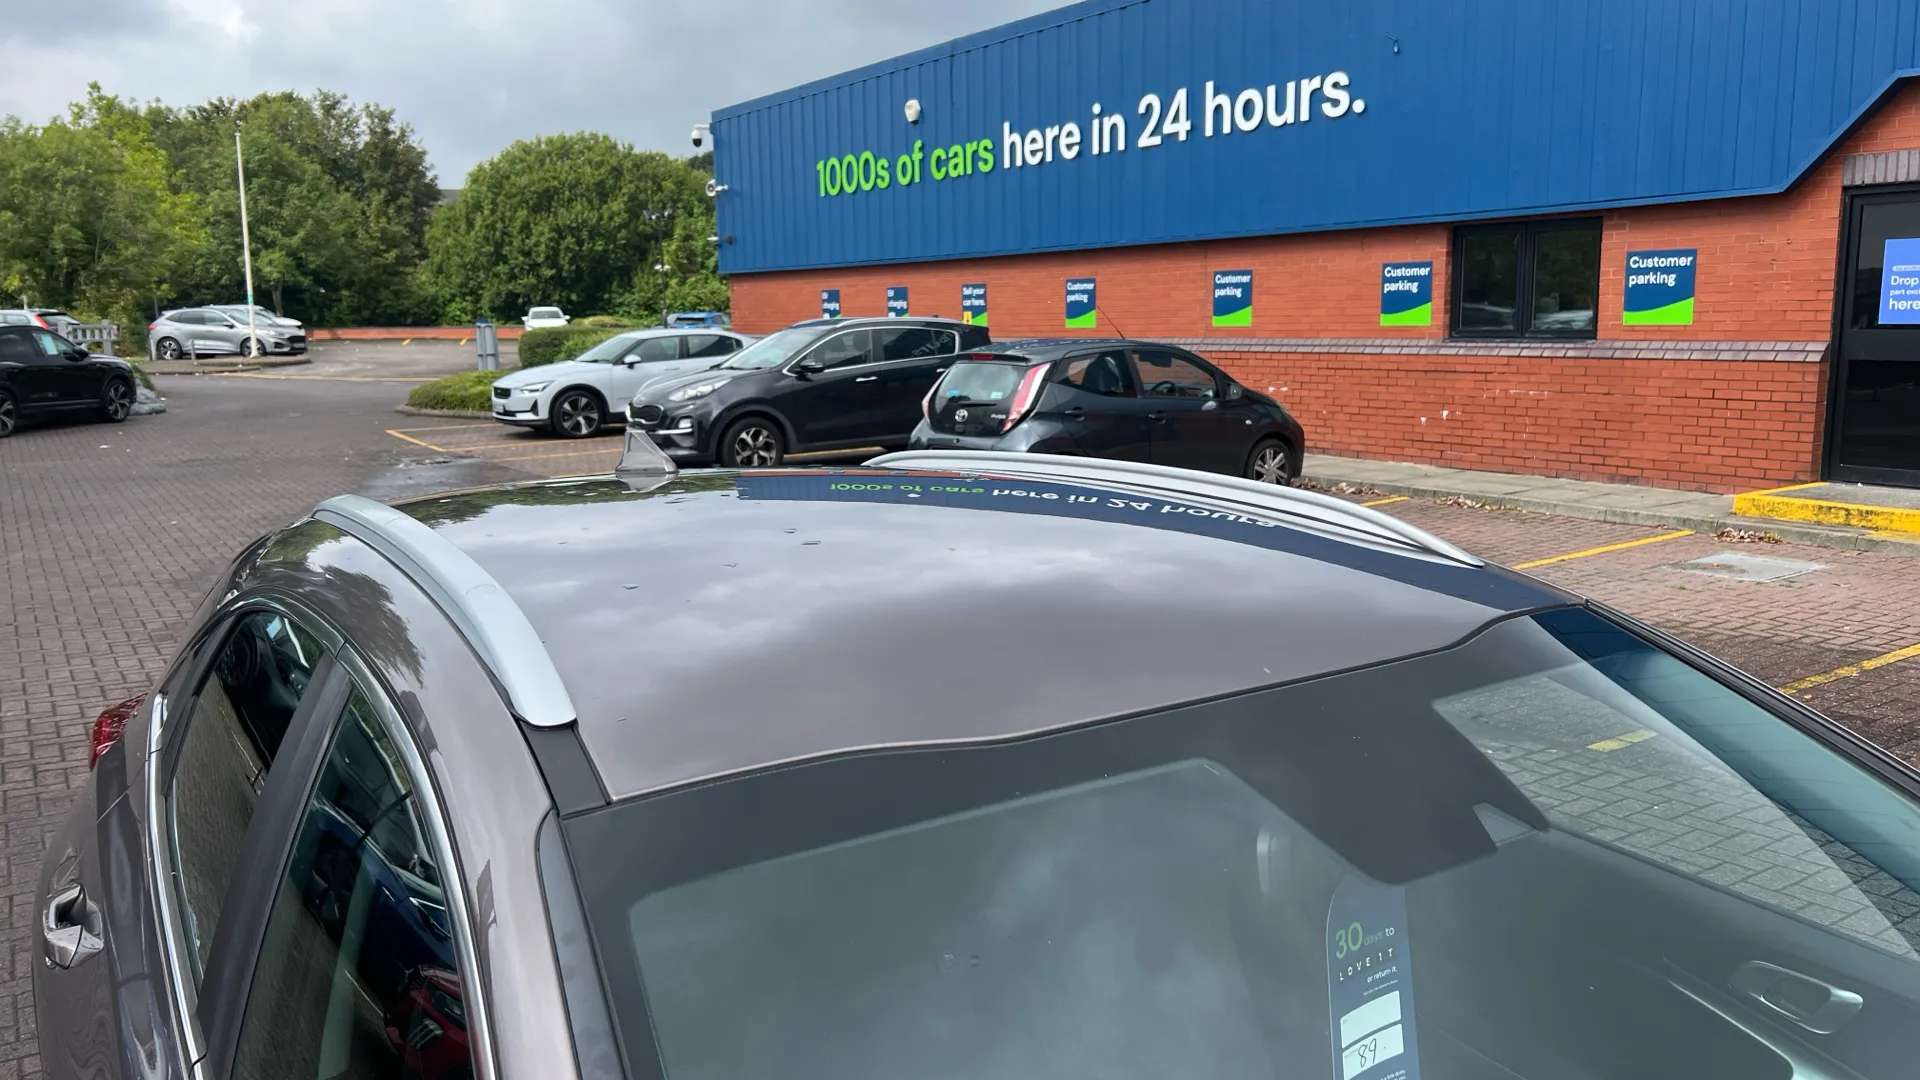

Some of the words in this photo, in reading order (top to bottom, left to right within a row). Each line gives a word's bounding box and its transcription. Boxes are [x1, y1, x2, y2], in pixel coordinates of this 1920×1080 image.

[816, 150, 891, 197] 1000s
[896, 139, 924, 187] of
[929, 138, 996, 181] cars
[1003, 120, 1081, 169] here
[1092, 102, 1126, 155] in
[1137, 88, 1192, 148] 24
[1204, 71, 1366, 137] hours.
[1629, 254, 1693, 269] Customer
[1384, 266, 1431, 278] Customer
[1214, 274, 1251, 284] Customer
[1629, 271, 1677, 287] parking
[1890, 275, 1920, 287] Drop
[1066, 282, 1095, 291] Customer
[1214, 287, 1242, 298] parking
[1383, 280, 1419, 294] parking
[1066, 293, 1089, 303] parking
[1335, 922, 1363, 960] 30
[1385, 927, 1396, 937] to
[1358, 1038, 1377, 1068] 89
